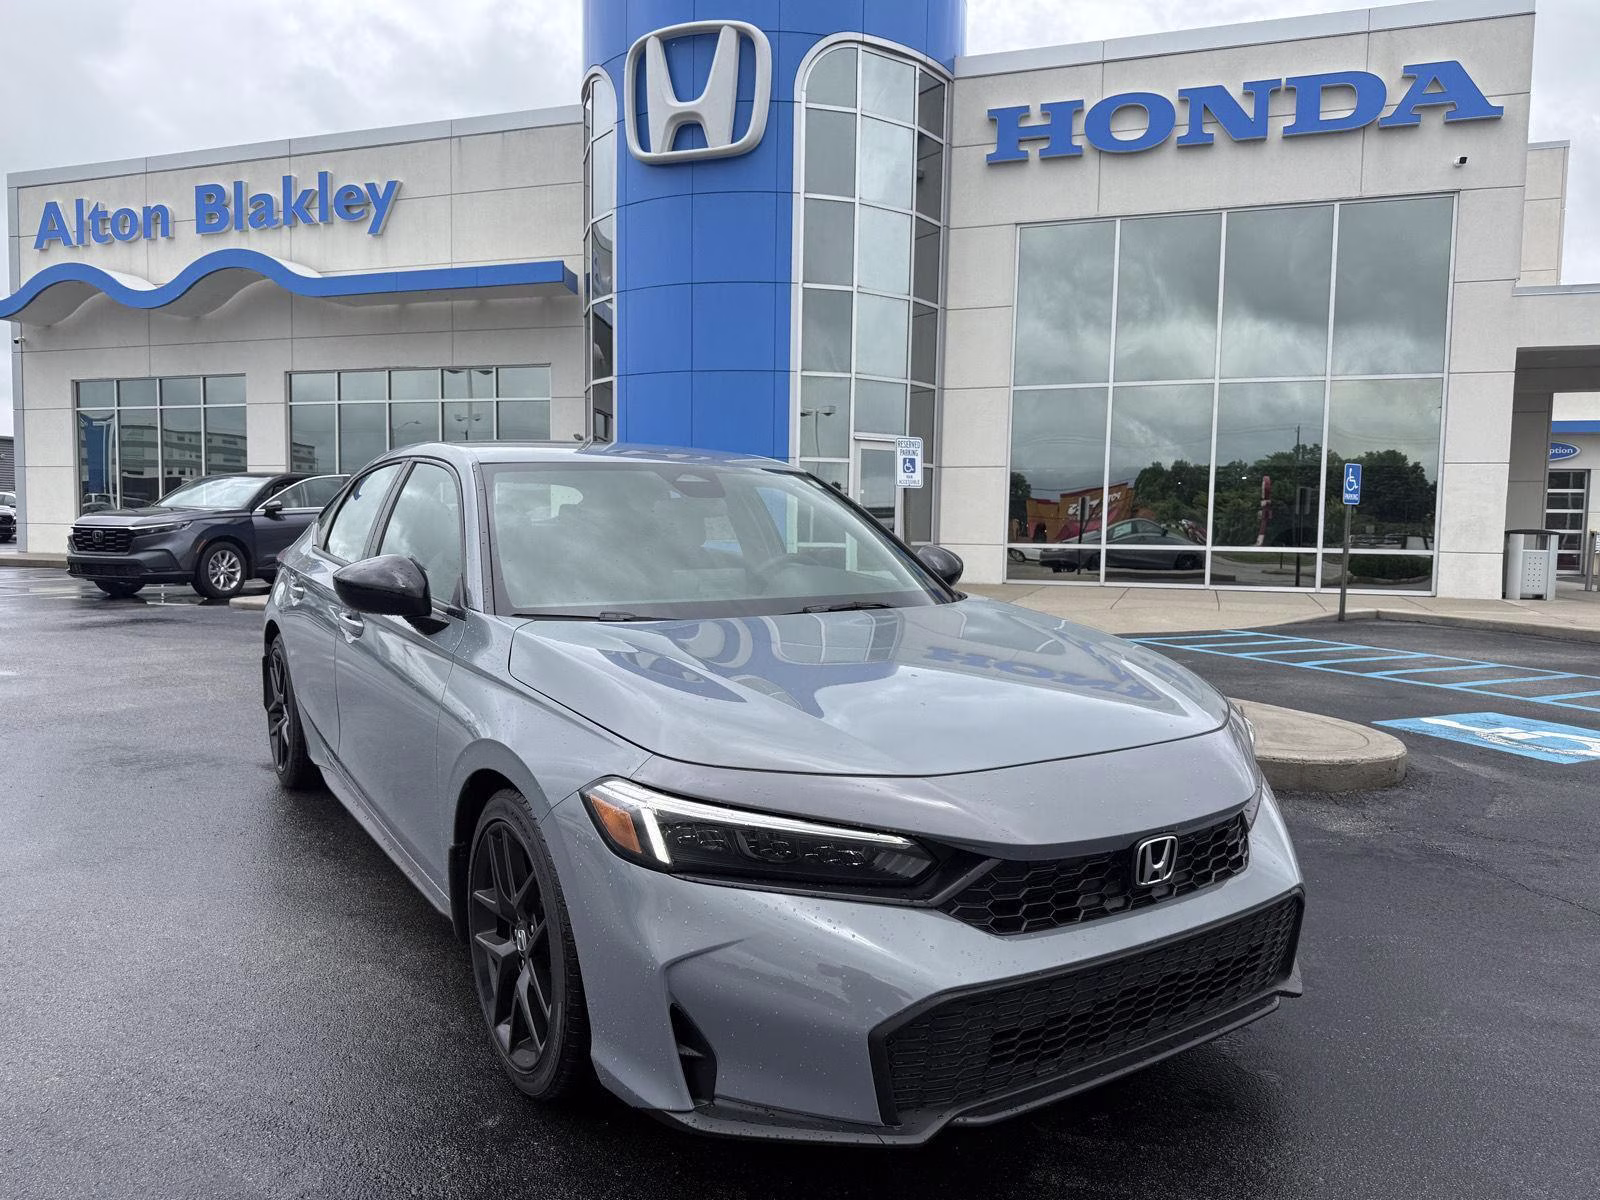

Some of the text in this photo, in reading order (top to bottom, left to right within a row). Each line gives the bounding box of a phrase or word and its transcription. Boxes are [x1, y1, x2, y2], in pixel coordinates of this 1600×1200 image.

[986, 60, 1504, 164] HONDA
[34, 171, 402, 250] Alton Blakley
[898, 440, 920, 448] RESERVED
[900, 449, 919, 457] PARKING
